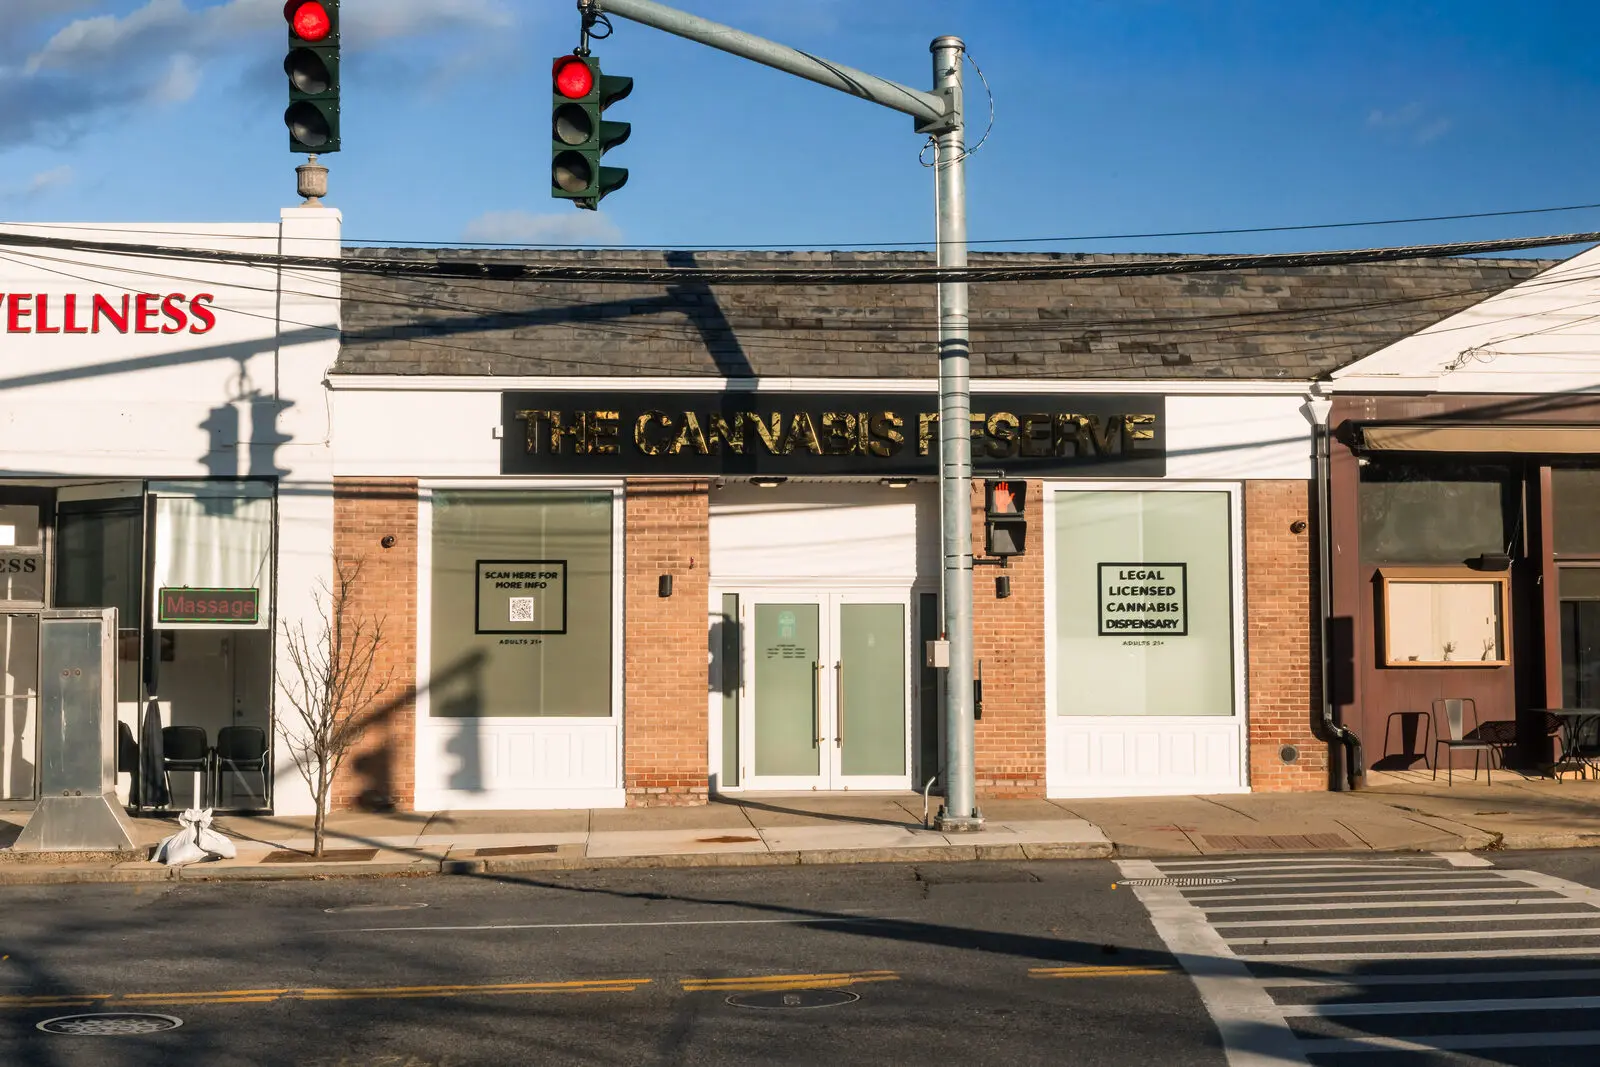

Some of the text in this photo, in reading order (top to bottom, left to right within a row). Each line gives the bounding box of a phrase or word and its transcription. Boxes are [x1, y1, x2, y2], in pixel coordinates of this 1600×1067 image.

[0, 293, 216, 334] ELLNESS
[515, 410, 620, 455] THE
[634, 410, 903, 457] CANNABIS
[485, 571, 558, 579] SCAN HERE FOR
[1119, 570, 1165, 581] LEGAL
[495, 581, 547, 589] MORE INFO
[1109, 586, 1176, 597] LICENSED
[167, 596, 254, 617] Massage
[1106, 602, 1179, 613] CANNABIS
[1106, 619, 1179, 629] DISPENSARY
